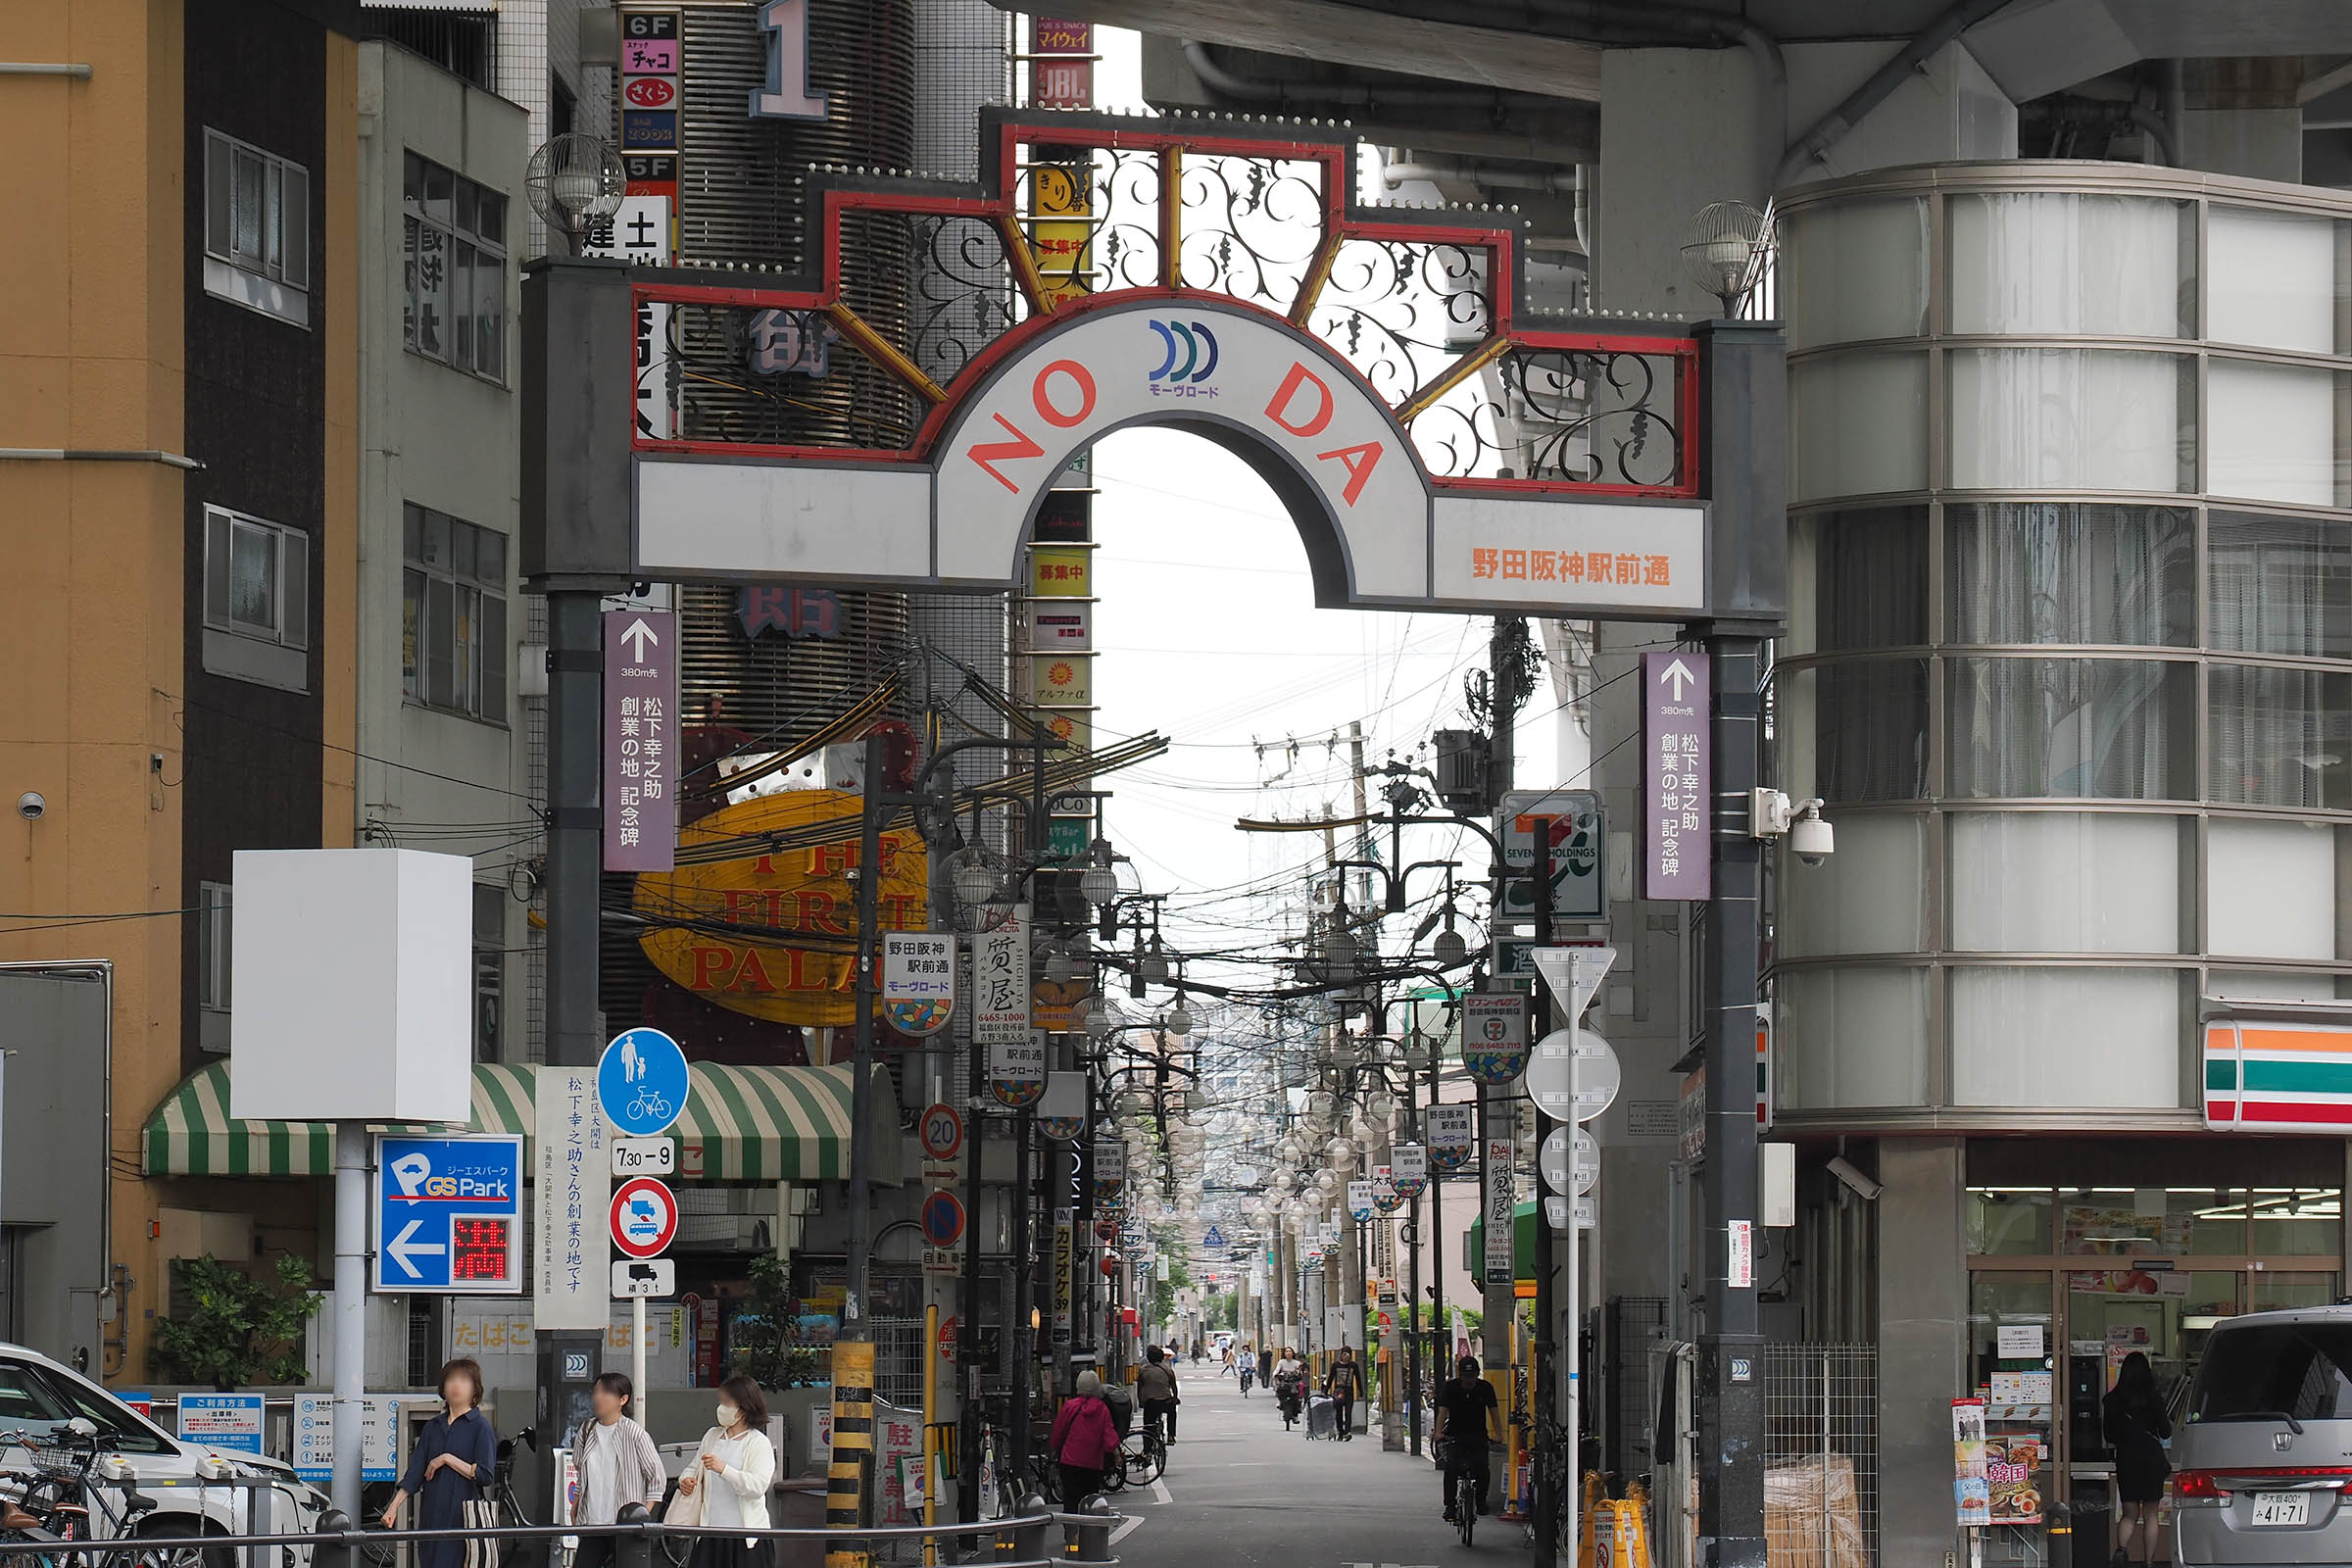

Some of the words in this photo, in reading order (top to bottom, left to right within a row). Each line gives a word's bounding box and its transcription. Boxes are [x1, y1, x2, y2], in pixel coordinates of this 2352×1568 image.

[630, 17, 670, 34] 6F
[1039, 31, 1088, 47] マイウェイ
[633, 51, 670, 69] チャコ
[632, 83, 668, 101] さくら
[1039, 70, 1087, 99] JBL
[630, 159, 670, 175] 5F
[1150, 384, 1218, 399] モーヴロード
[1039, 564, 1083, 580] 募集中
[1473, 548, 1670, 586] 野田阪神駅前通
[620, 668, 658, 678] 380m先
[1661, 707, 1694, 715] 380m先
[620, 697, 639, 777] 創業の地
[643, 697, 662, 799] 松下幸之助
[1661, 734, 1679, 811] 創業の地
[1682, 734, 1698, 831] 松下幸之助
[620, 787, 639, 847] 記念碑
[1548, 848, 1595, 858] HOLDINGS
[1661, 819, 1679, 877] 記念碑
[721, 890, 916, 933] FIRT
[889, 942, 945, 956] 野田阪神
[907, 959, 949, 973] 駅前通
[987, 936, 1016, 1010] 質屋
[889, 981, 949, 992] モーヴロード
[978, 1012, 1025, 1022] 6465-1000
[1006, 1050, 1043, 1060] 駅前通
[992, 1066, 1042, 1075] モーヴロード
[1429, 1110, 1464, 1119] 野田阪神
[930, 1120, 954, 1144] 20
[1442, 1121, 1467, 1130] 駅前通
[447, 1166, 509, 1176] ジーエスパーク
[425, 1177, 458, 1197] GS
[460, 1179, 509, 1198] Park
[566, 1077, 583, 1294] 松下幸之助さんの創業の地です
[454, 1221, 507, 1278] 満
[924, 1252, 959, 1263] 自動車
[455, 1323, 530, 1347] たばこ
[197, 1398, 246, 1407] ご利用方法
[1991, 1464, 2027, 1483] 韓国
[2265, 1505, 2303, 1522] 41-71
